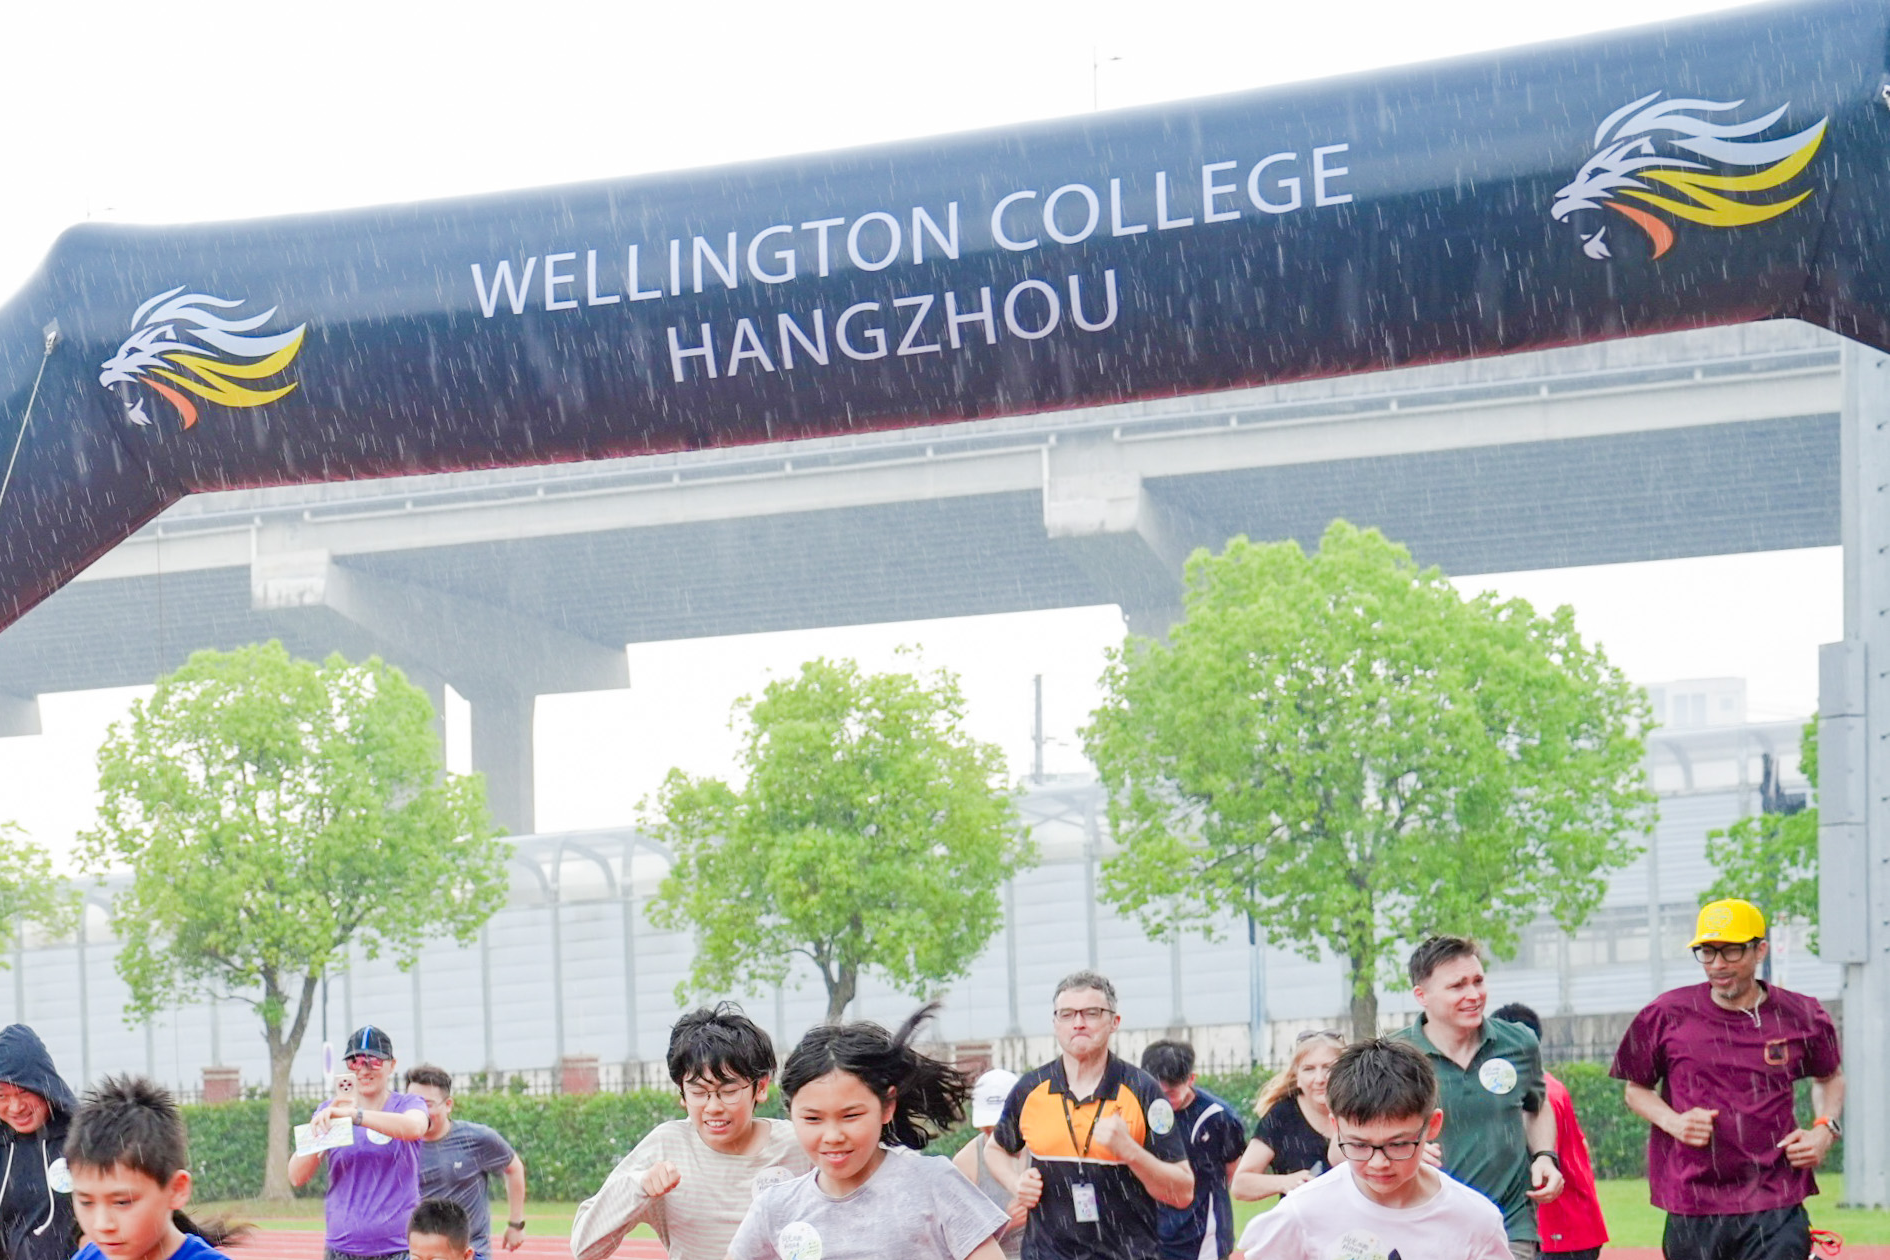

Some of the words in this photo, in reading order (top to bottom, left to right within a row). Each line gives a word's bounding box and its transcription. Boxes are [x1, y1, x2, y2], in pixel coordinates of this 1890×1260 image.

[471, 201, 959, 318] WELLINGTON
[991, 143, 1353, 252] COLLEGE
[667, 269, 1118, 382] HANGZHOU
